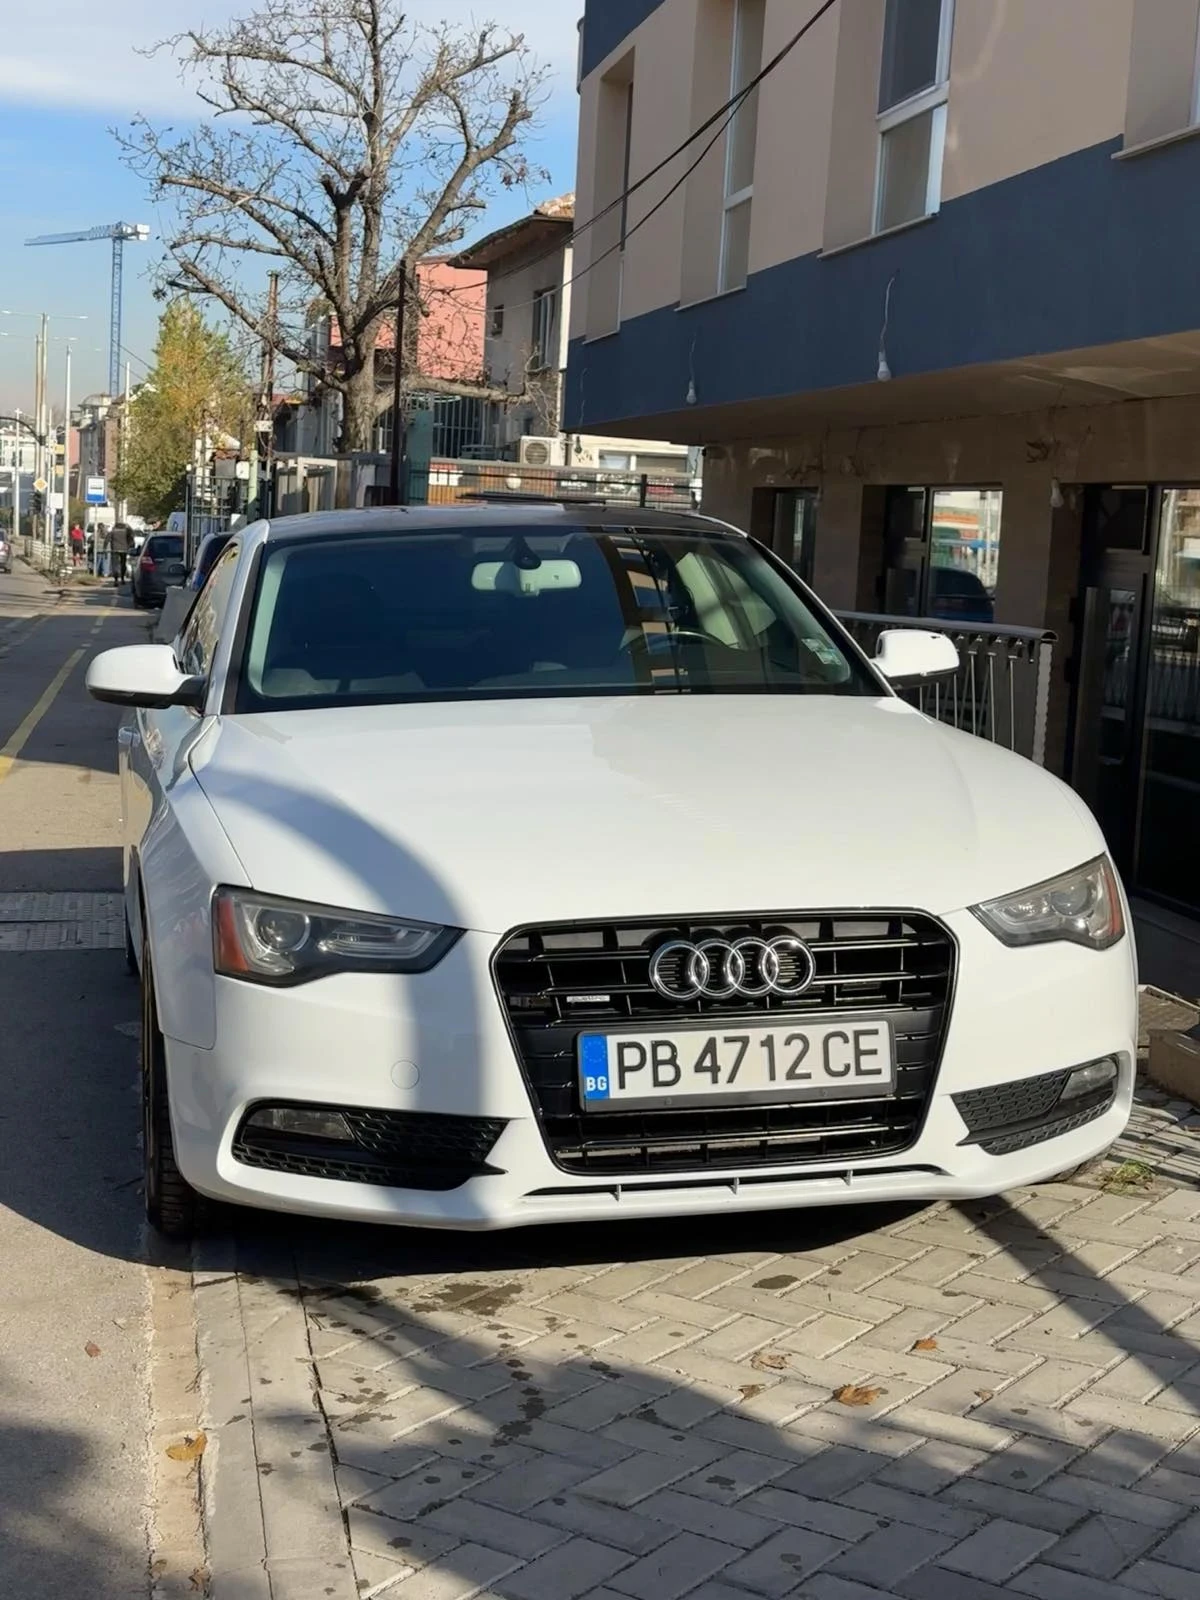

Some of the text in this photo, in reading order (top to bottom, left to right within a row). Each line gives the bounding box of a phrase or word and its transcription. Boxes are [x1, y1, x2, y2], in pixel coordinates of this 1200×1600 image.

[617, 1029, 882, 1090] PB 4712 CE
[586, 1076, 607, 1091] BG
